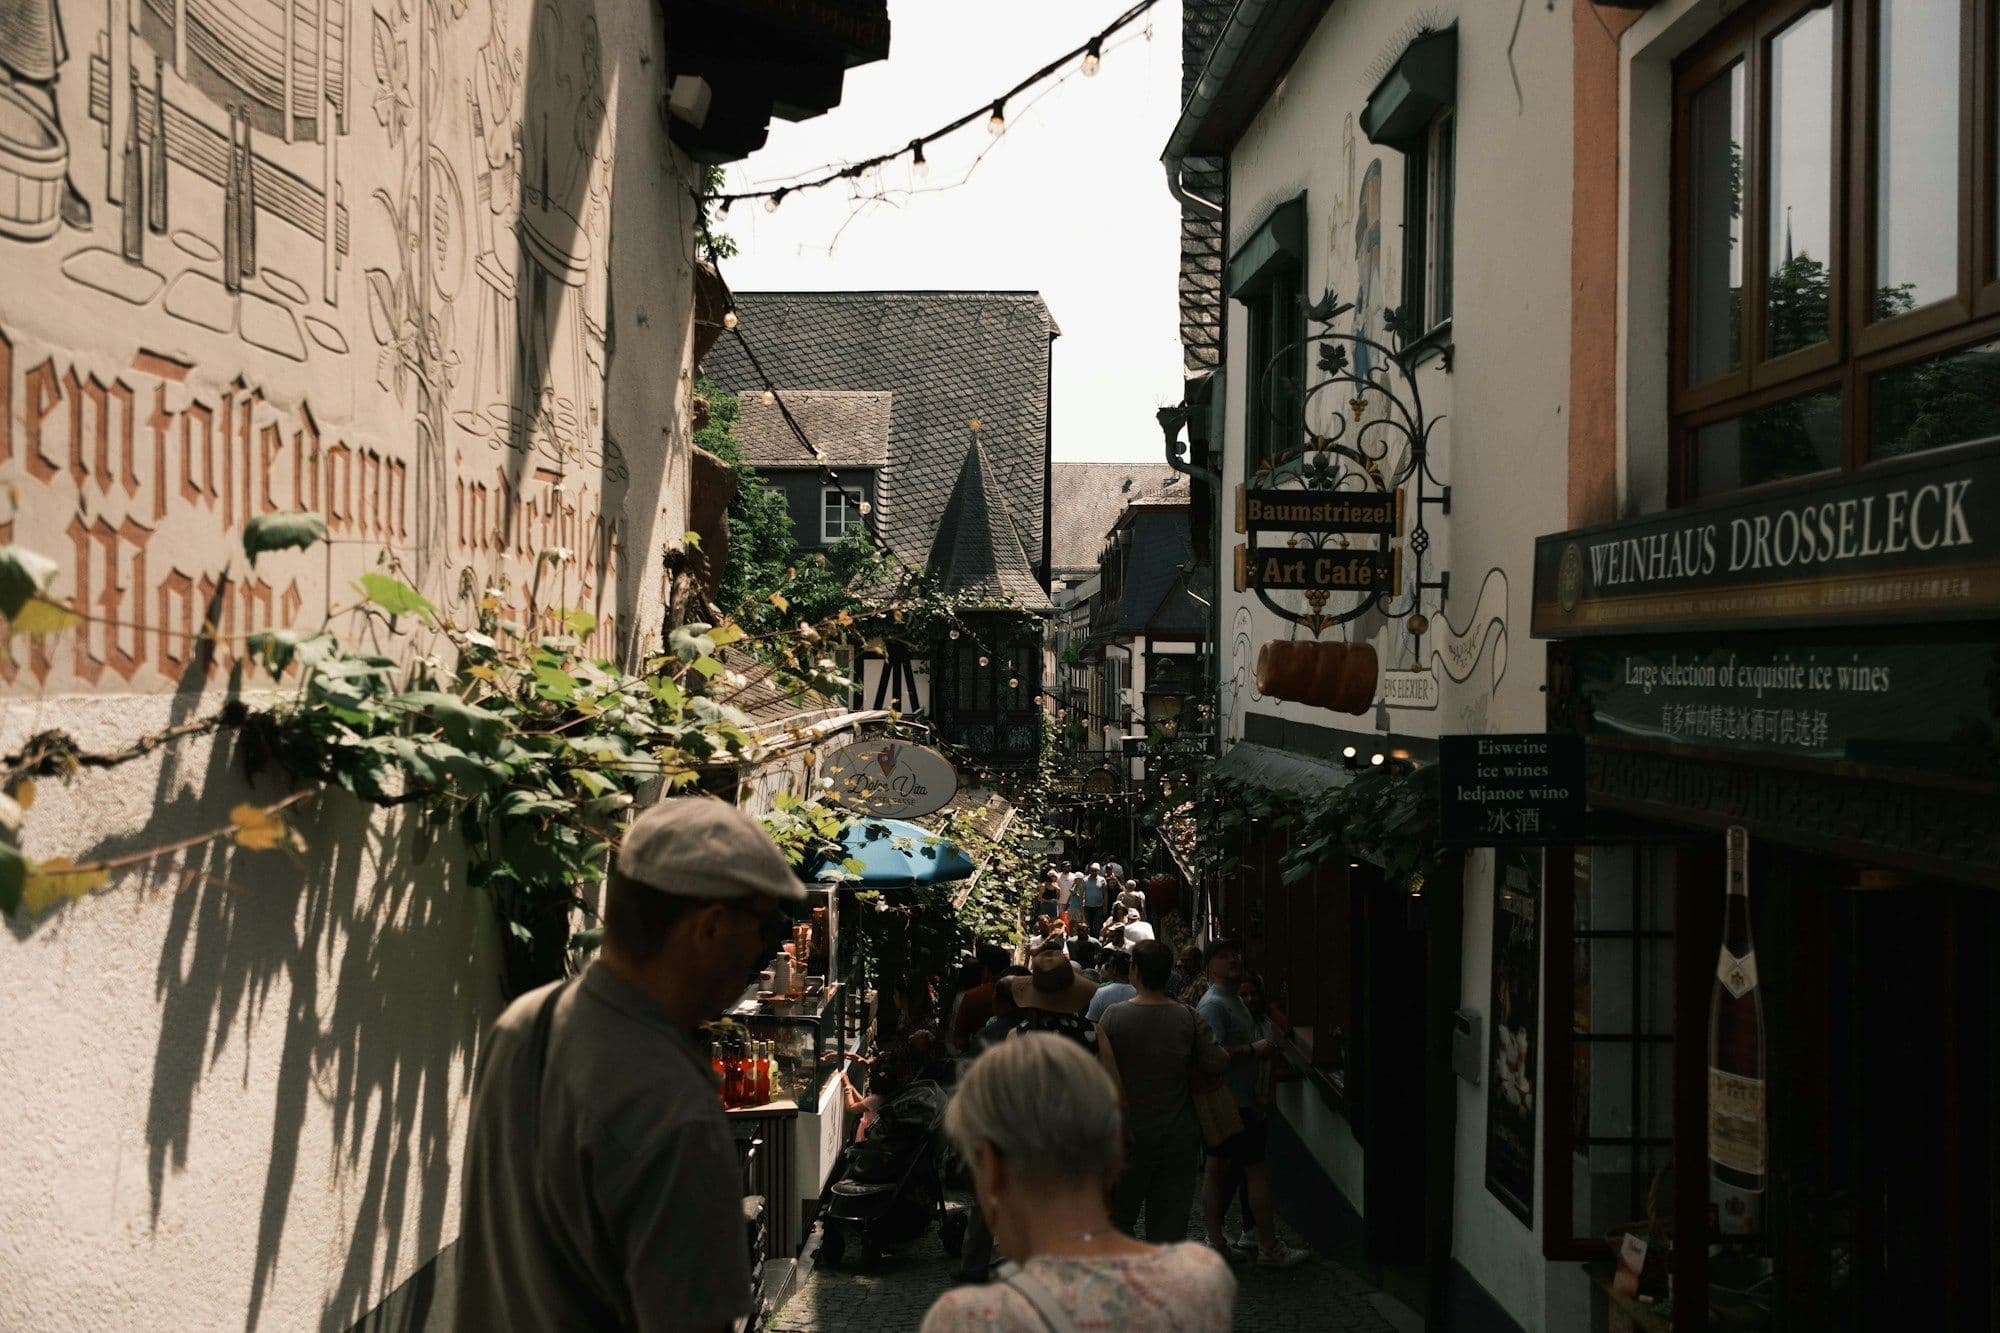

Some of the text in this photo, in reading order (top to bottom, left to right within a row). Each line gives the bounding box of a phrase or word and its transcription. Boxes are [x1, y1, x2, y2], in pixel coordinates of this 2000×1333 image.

[0, 326, 141, 500] em
[1247, 499, 1393, 524] Baumstriezel
[1589, 478, 1974, 589] WEINHAUS DROSSELECK
[1262, 557, 1373, 586] Art Café
[1624, 652, 1890, 699] Large selection of exquisite ice wines
[1477, 738, 1548, 756] Eisweine
[1477, 762, 1550, 778] ice wines
[892, 773, 928, 797] Vita
[1456, 784, 1571, 806] ledjanoe wino
[1486, 807, 1542, 835] 冰酒
